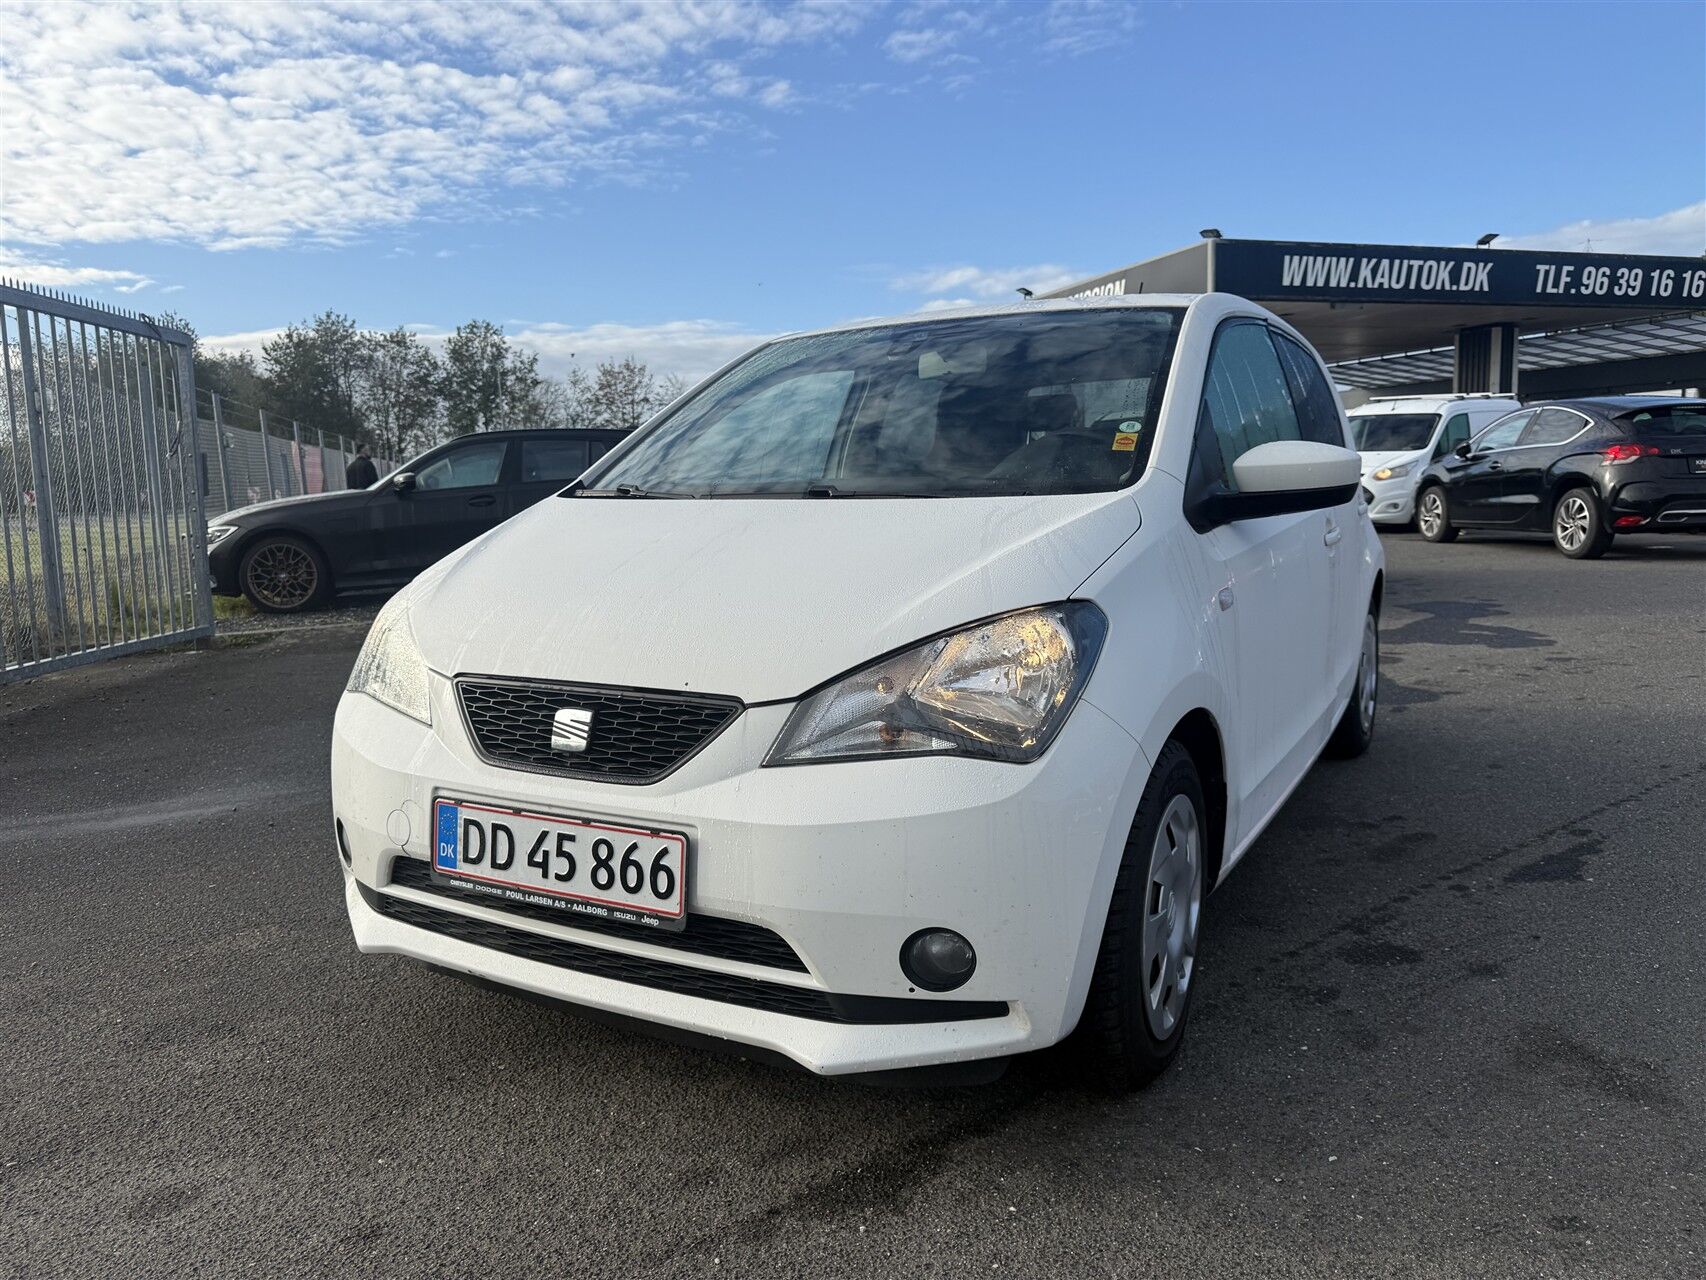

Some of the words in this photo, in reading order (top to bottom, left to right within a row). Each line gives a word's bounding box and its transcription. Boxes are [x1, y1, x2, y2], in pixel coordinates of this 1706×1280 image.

[1282, 255, 1494, 292] WWW.KAUTOK.DK
[1535, 264, 1577, 294] TLF.
[1581, 266, 1610, 295] 96
[1613, 267, 1643, 297] 39
[1650, 269, 1675, 297] 16
[1682, 270, 1706, 298] 16
[440, 842, 455, 858] DK
[462, 817, 515, 871] DD
[527, 829, 577, 882] 45
[590, 837, 676, 900] 866
[450, 880, 474, 889] CHRYSLER
[475, 885, 503, 894] DODGE
[506, 890, 524, 900] POUL
[525, 893, 553, 906] LARSEN
[554, 900, 566, 909] A/S
[572, 903, 608, 916] AALBORG
[613, 911, 636, 921] ISUZU
[641, 915, 660, 926] Jeep
